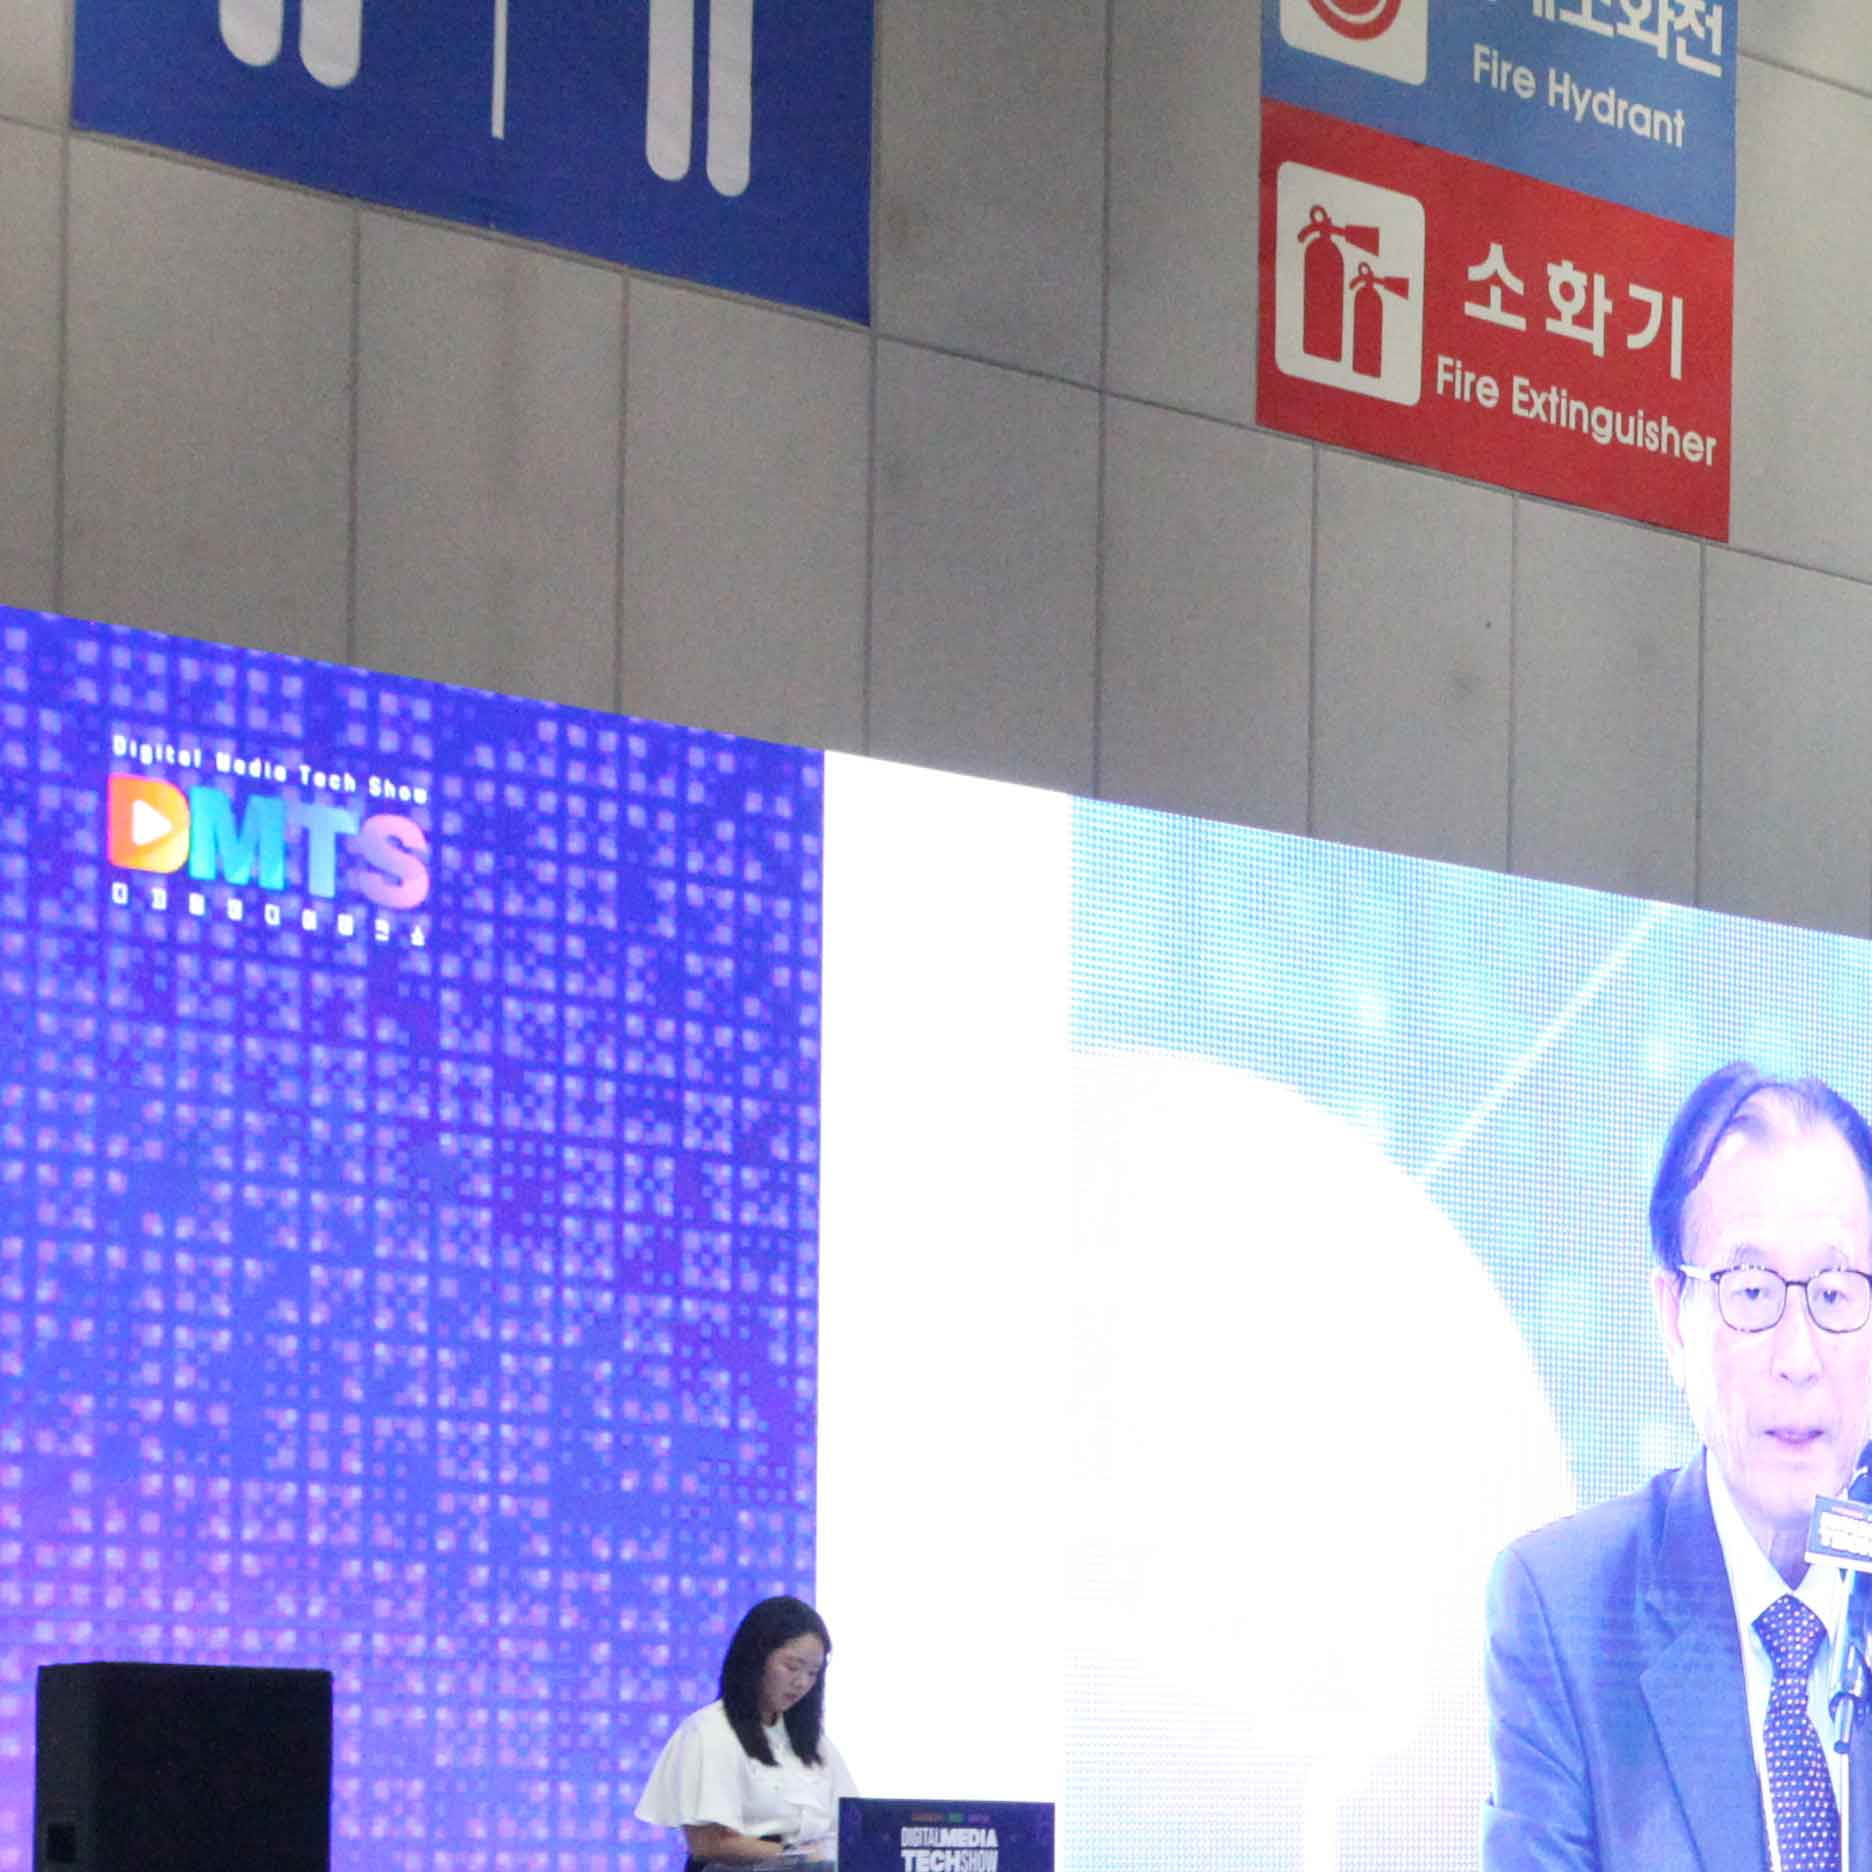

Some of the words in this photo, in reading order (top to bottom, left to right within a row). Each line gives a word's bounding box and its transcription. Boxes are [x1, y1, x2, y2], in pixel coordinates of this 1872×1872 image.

[1473, 43, 1536, 98] Fire
[1548, 68, 1686, 148] Hydrant
[1463, 242, 1684, 380] 소화기
[1436, 355, 1500, 409] Fire
[1512, 376, 1717, 466] Extinguisher
[112, 734, 202, 768] Digital
[299, 764, 357, 792] Tech
[107, 772, 431, 910] DMTS
